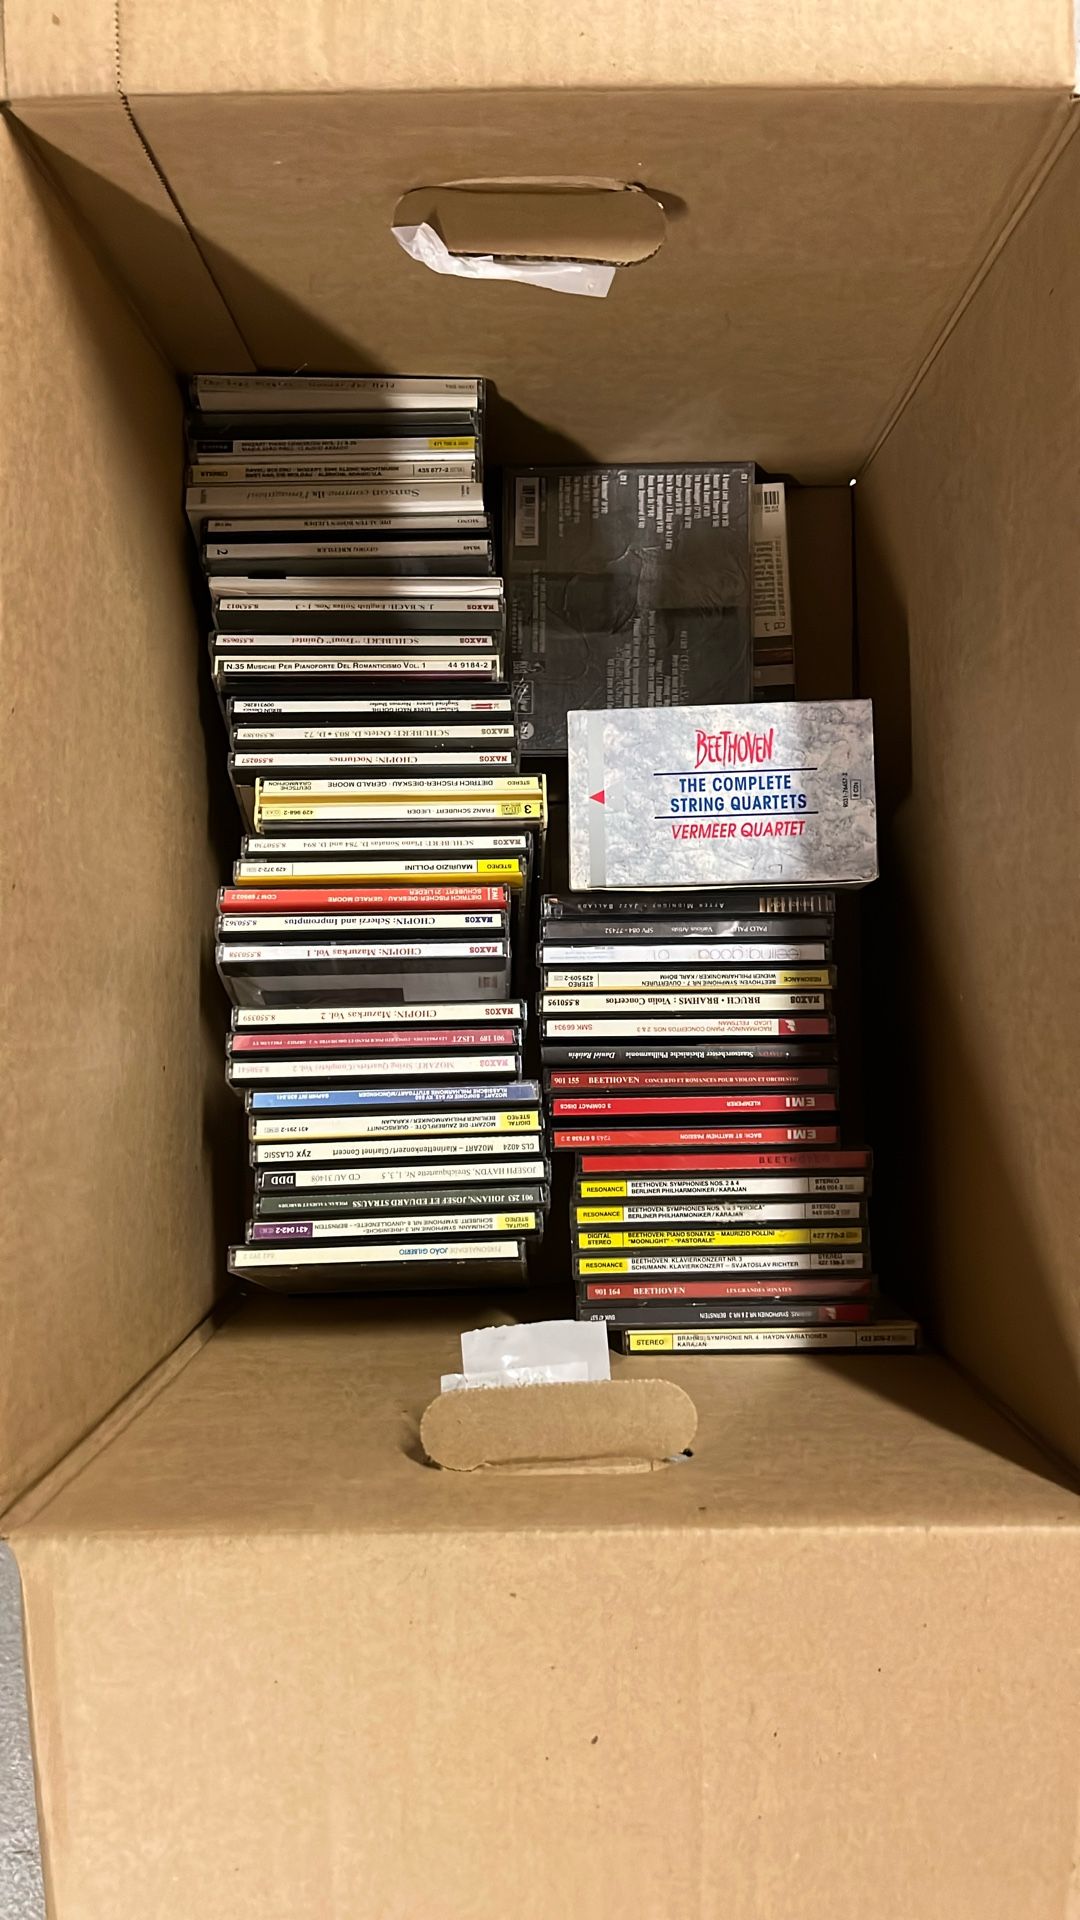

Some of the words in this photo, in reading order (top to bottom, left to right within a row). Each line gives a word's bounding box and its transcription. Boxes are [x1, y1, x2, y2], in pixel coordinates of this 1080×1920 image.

[694, 728, 774, 769] BEETHOVEN
[329, 757, 372, 765] Nocturnes
[479, 755, 507, 763] NAXOS
[679, 777, 706, 792] THE
[712, 774, 791, 791] COMPLETE
[670, 796, 724, 812] STRING
[730, 793, 808, 810] QUARTETS
[524, 804, 531, 813] 3
[671, 823, 737, 839] VERMEER
[740, 820, 807, 837] QUARTET
[435, 864, 472, 872] MAURIZIO
[605, 997, 645, 1005] Concertos
[789, 995, 821, 1004] NAXOS
[485, 1007, 513, 1015] NAXOS
[589, 1076, 640, 1084] BEETHOVEN
[785, 1096, 814, 1107] EMI
[786, 1129, 815, 1139] EMI
[361, 1145, 457, 1157] Klarinettenkonzert/Clarinet
[464, 1144, 493, 1154] MOZART
[502, 1143, 520, 1152] 4024
[520, 1143, 534, 1152] CLS
[263, 1150, 294, 1158] CLASSIC
[472, 1167, 504, 1175] HAYDN,
[505, 1166, 536, 1178] JOSEPH
[271, 1176, 294, 1184] DDD
[276, 1226, 294, 1234] 042-2
[595, 1288, 607, 1296] 901
[609, 1288, 620, 1296] 164
[633, 1287, 685, 1295] BEETHOVEN
